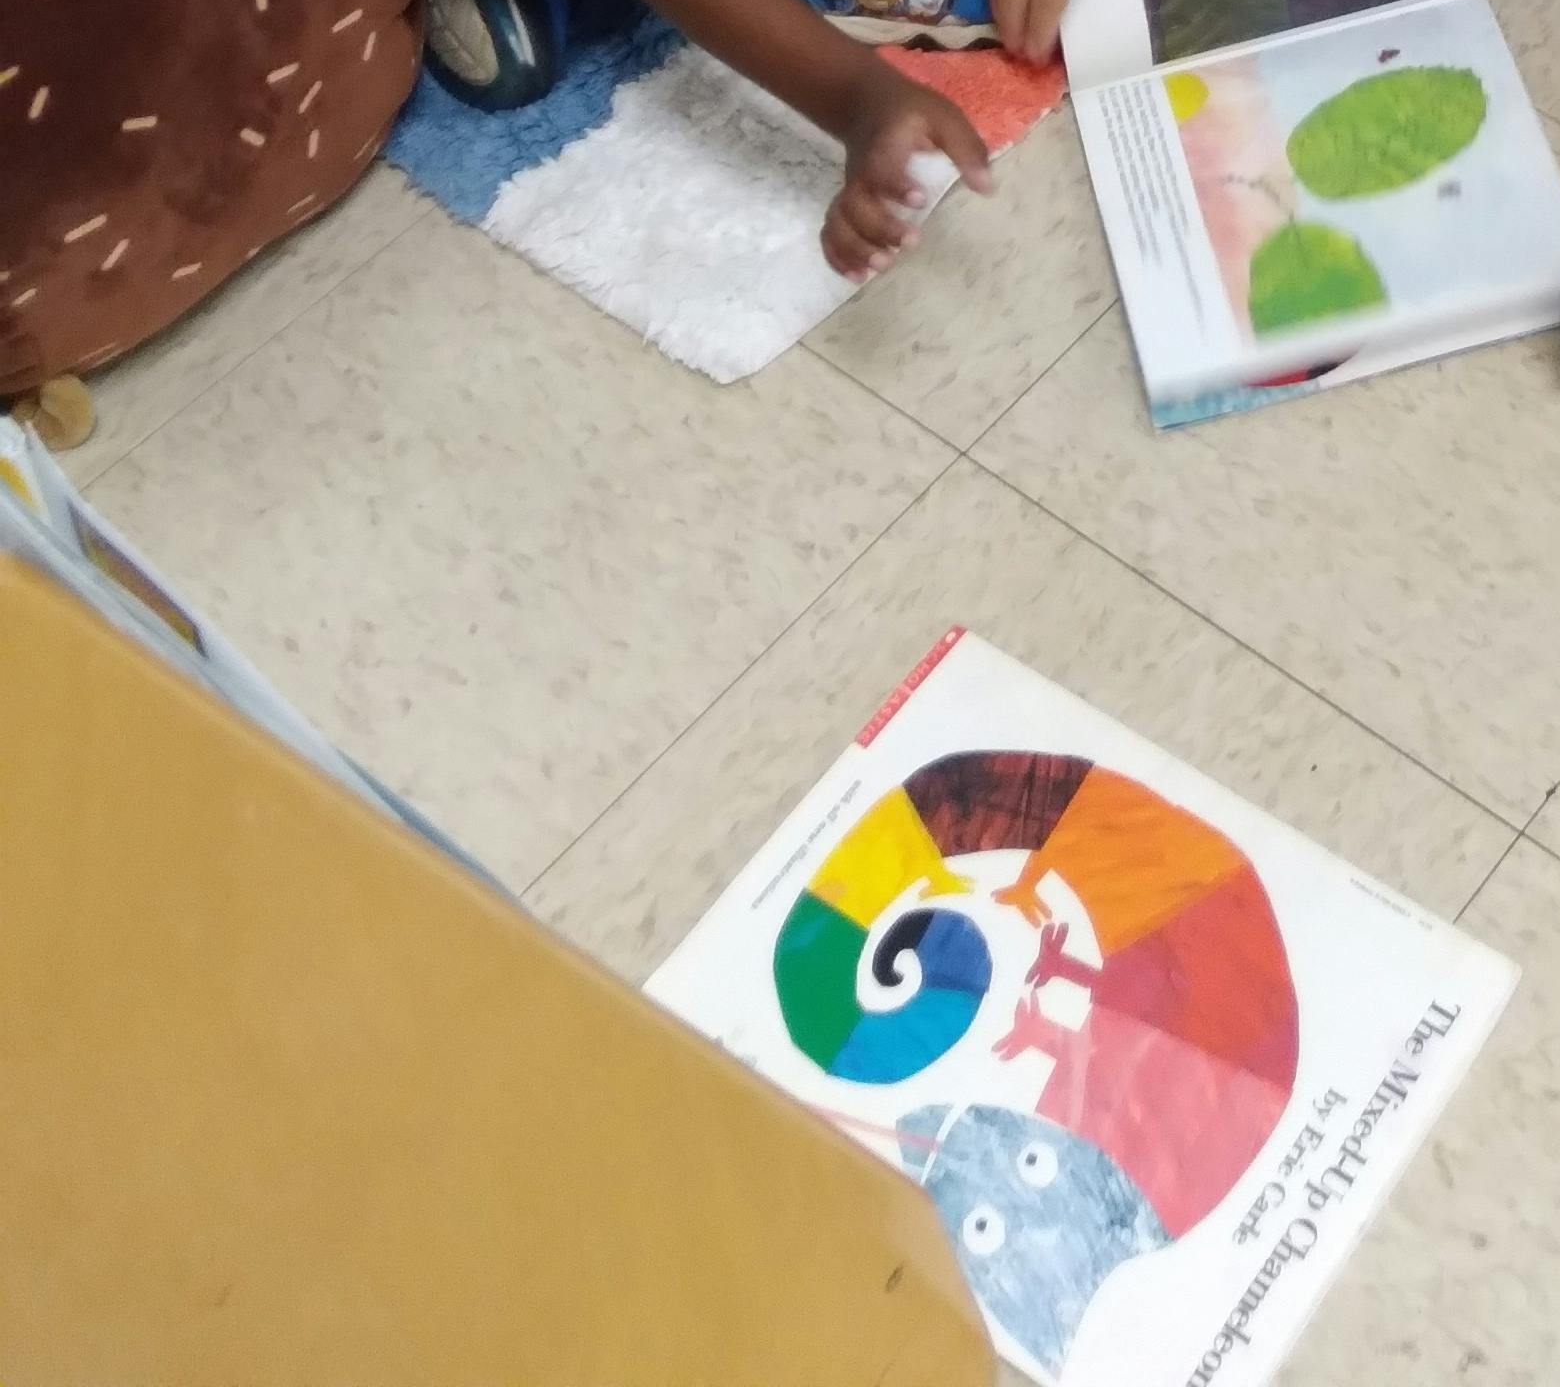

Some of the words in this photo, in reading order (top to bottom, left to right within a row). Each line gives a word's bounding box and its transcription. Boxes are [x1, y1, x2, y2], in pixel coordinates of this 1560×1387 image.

[1405, 998, 1462, 1056] The
[1312, 1087, 1348, 1121] by
[1278, 1124, 1325, 1178] Eric
[1303, 1059, 1421, 1211] Mixed-Up
[1232, 1181, 1286, 1246] Carle
[1185, 1217, 1318, 1387] Chameleon
